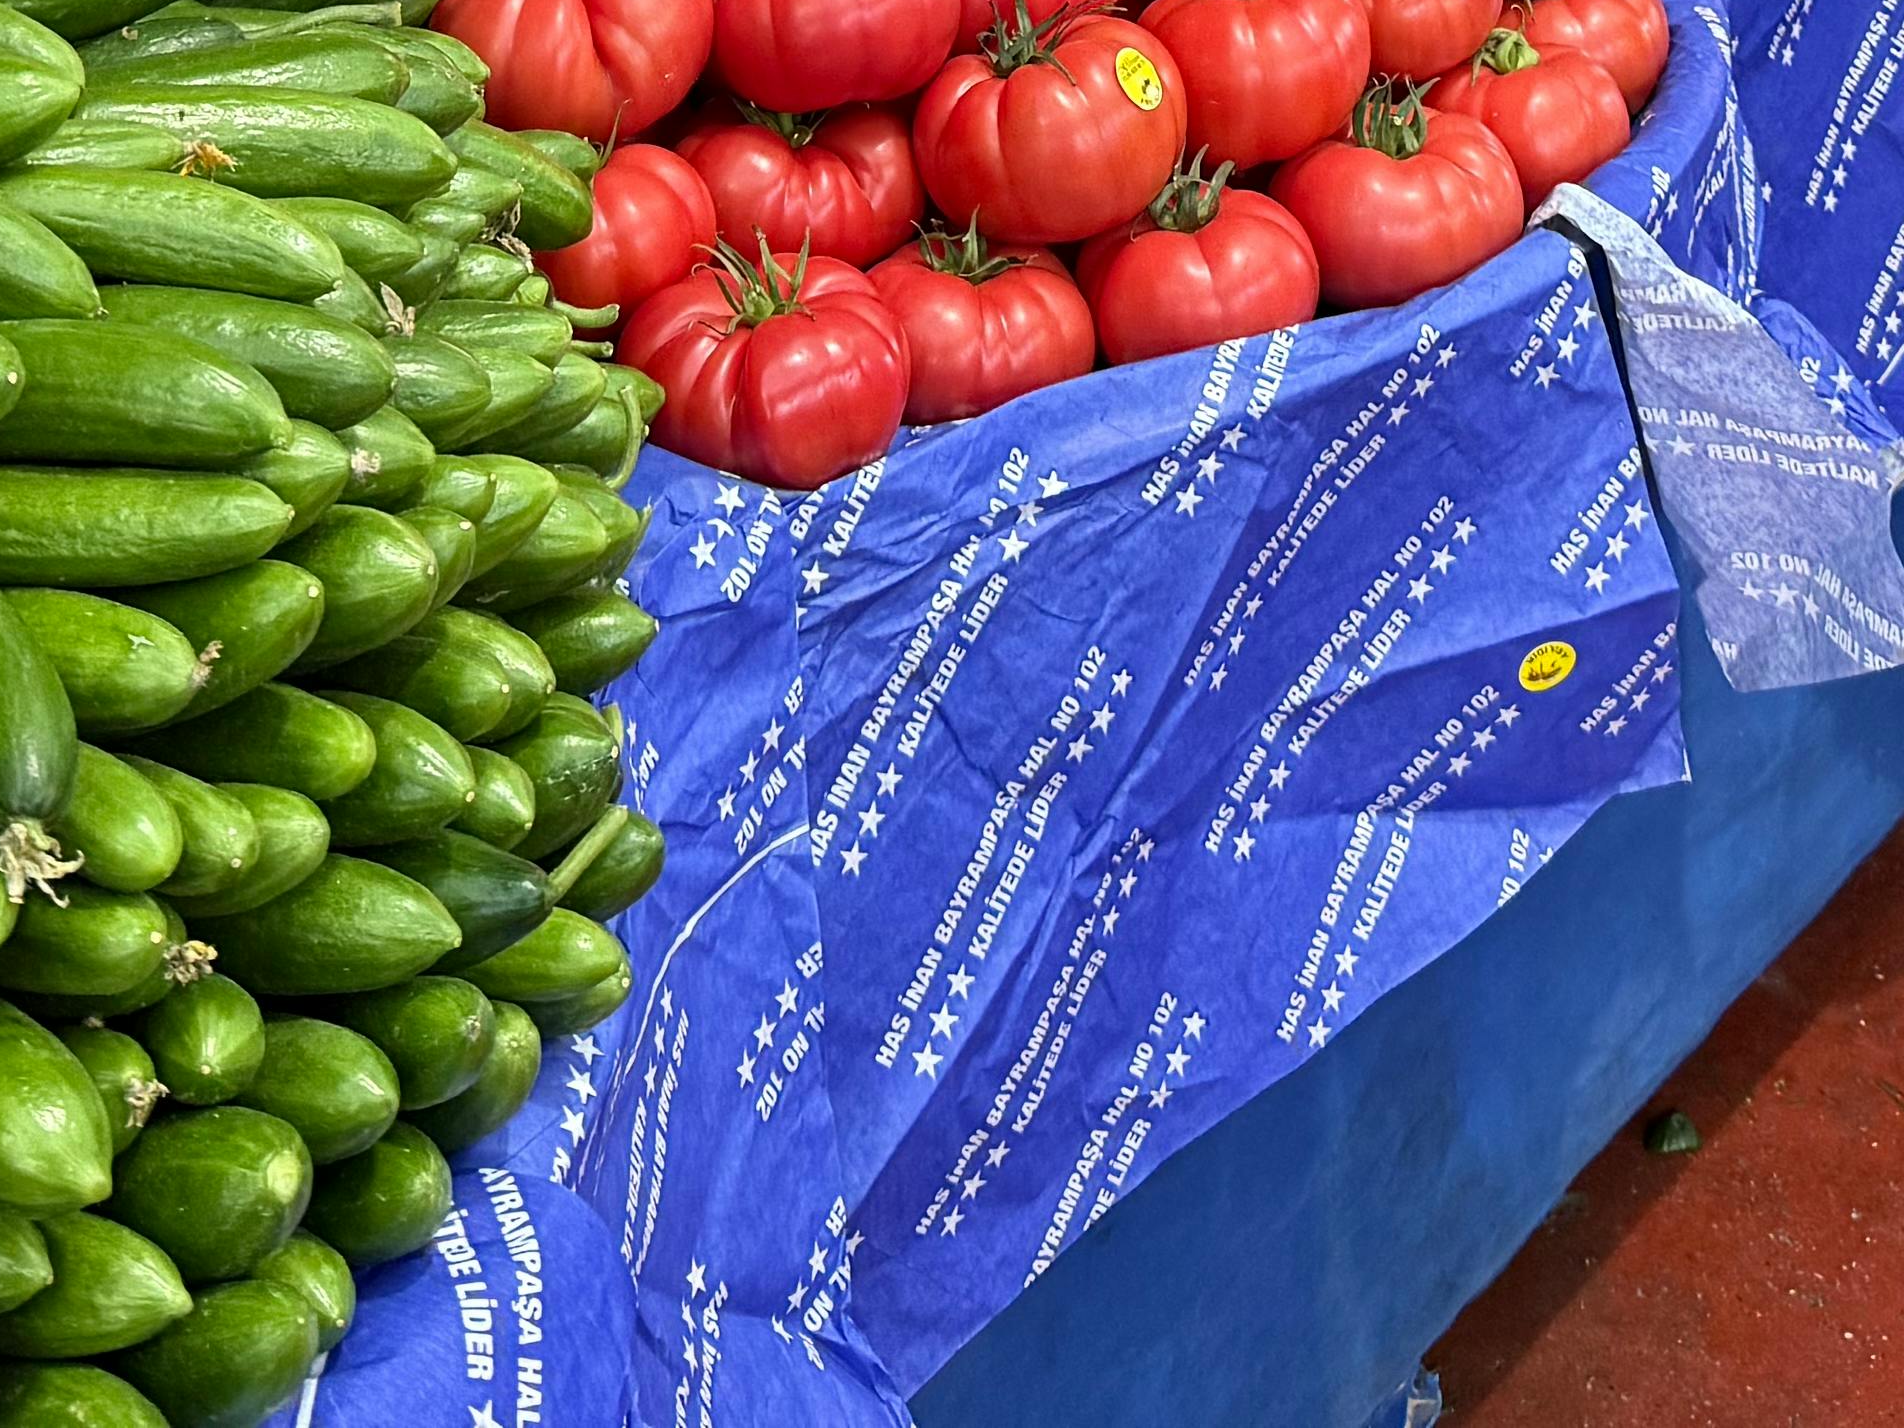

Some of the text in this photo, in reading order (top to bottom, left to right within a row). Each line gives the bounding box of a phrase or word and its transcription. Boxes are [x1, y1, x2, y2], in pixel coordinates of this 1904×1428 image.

[1835, 9, 1888, 126] BAYRAMPAŞA
[1850, 62, 1900, 137] KALİTEDE
[1804, 169, 1826, 208] HAS
[1814, 124, 1839, 169] İNAN
[1509, 276, 1574, 379] HAS İNAN
[1854, 316, 1877, 355] HAS
[1864, 271, 1895, 318] İNAN
[1183, 322, 1440, 687] HAS İNAN BAYRAMPAŞA HAL NO 102
[1266, 433, 1387, 589] KALİTEDE LİDER
[1549, 475, 1626, 576] HAS İNAN
[825, 445, 1031, 817] İNAN BAYRAMPAŞA 102
[896, 572, 1010, 760] KALİTEDE LİDER
[1204, 494, 1456, 854] HAS İNAN BAYRAMPAŞA HAL NO 102
[1287, 607, 1412, 756] KALİTEDE LİDER
[733, 764, 791, 855] NO 102
[874, 646, 1109, 1070] HAS İNAN BAYRAMPAŞA HAL NO 102
[967, 770, 1069, 962] KALİTEDE LİDER
[1276, 683, 1501, 1044] HAS İNAN BAYRAMPAŞA HAL NO 102
[1350, 778, 1449, 942] KALİTEDE LİDER
[755, 1032, 812, 1123] NO 102
[456, 1278, 499, 1383] LİDER
